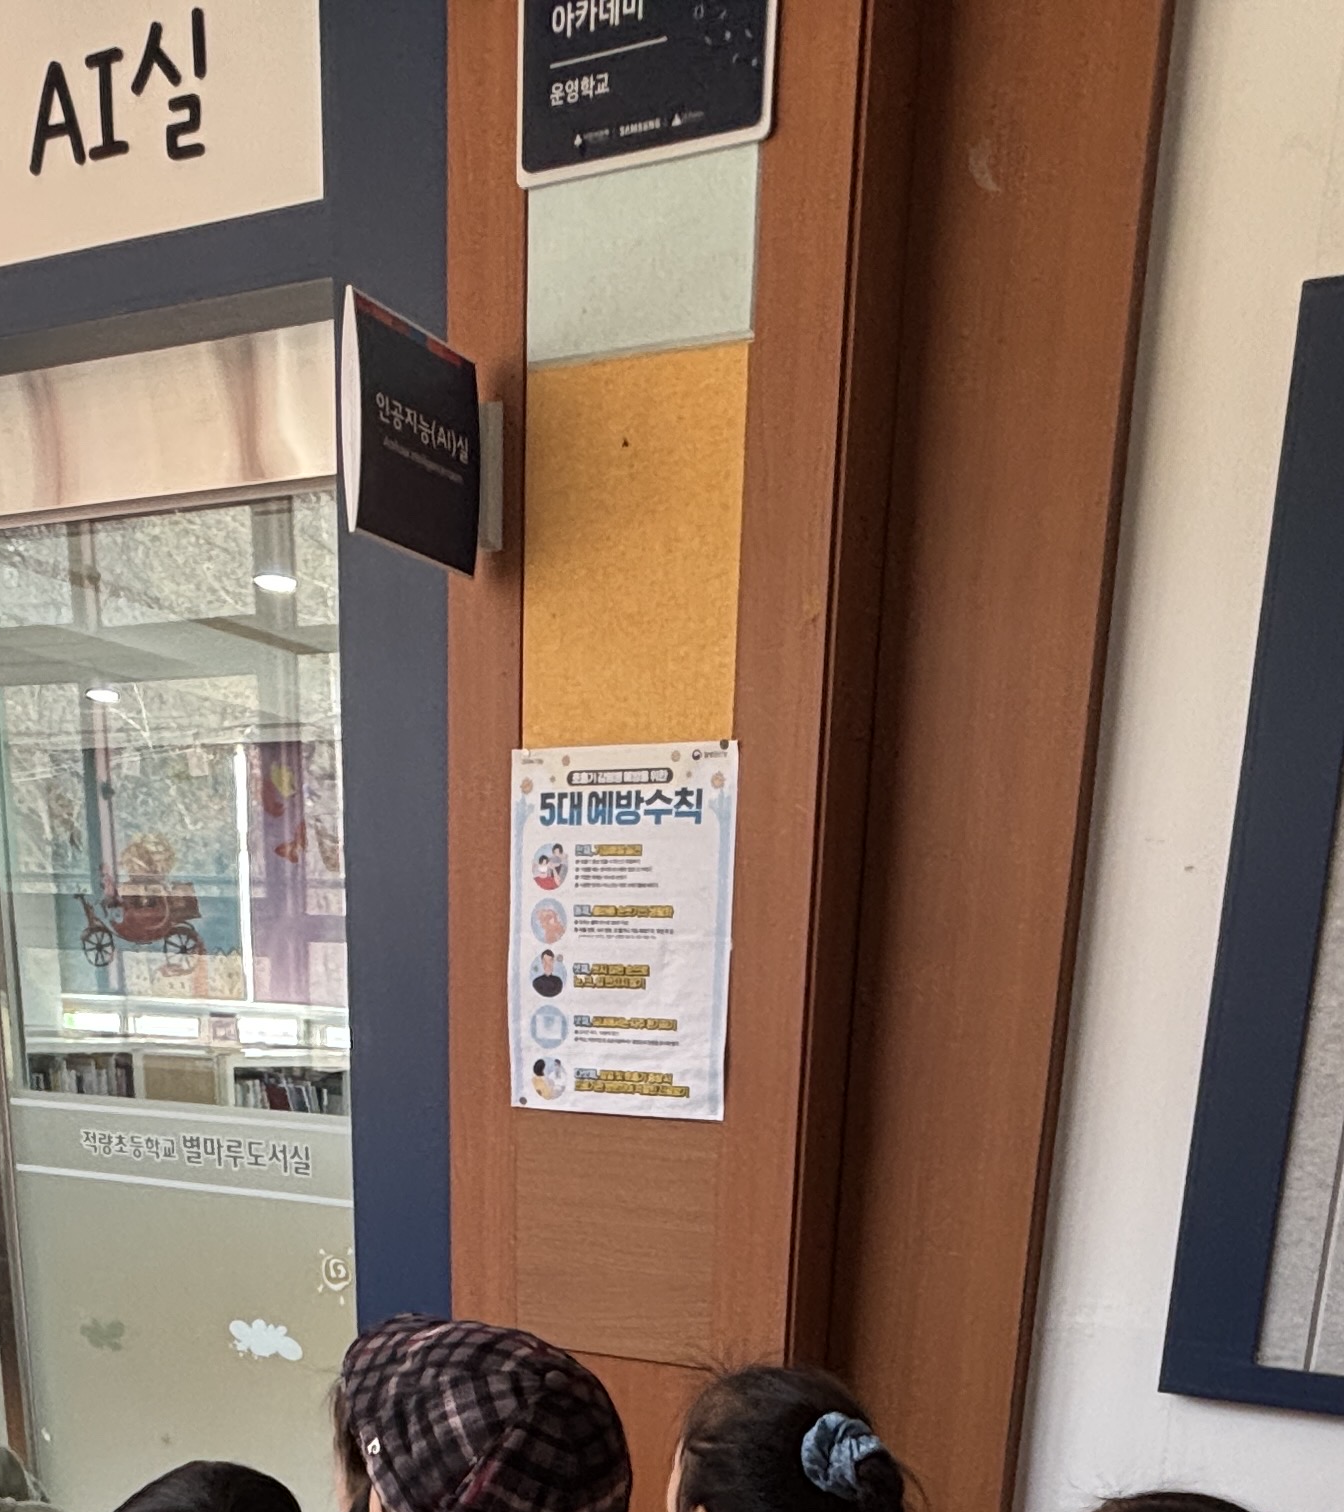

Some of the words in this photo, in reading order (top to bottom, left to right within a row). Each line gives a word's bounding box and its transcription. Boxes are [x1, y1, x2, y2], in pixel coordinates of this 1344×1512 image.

[28, 6, 209, 177] AI실
[549, 71, 610, 107] 운영학교
[619, 117, 661, 137] SAMSUNG
[375, 391, 469, 465] 인공지능(AI)실
[539, 791, 583, 827] 5대
[586, 787, 704, 827] 예방수칙
[181, 1133, 313, 1178] 별마루도서실
